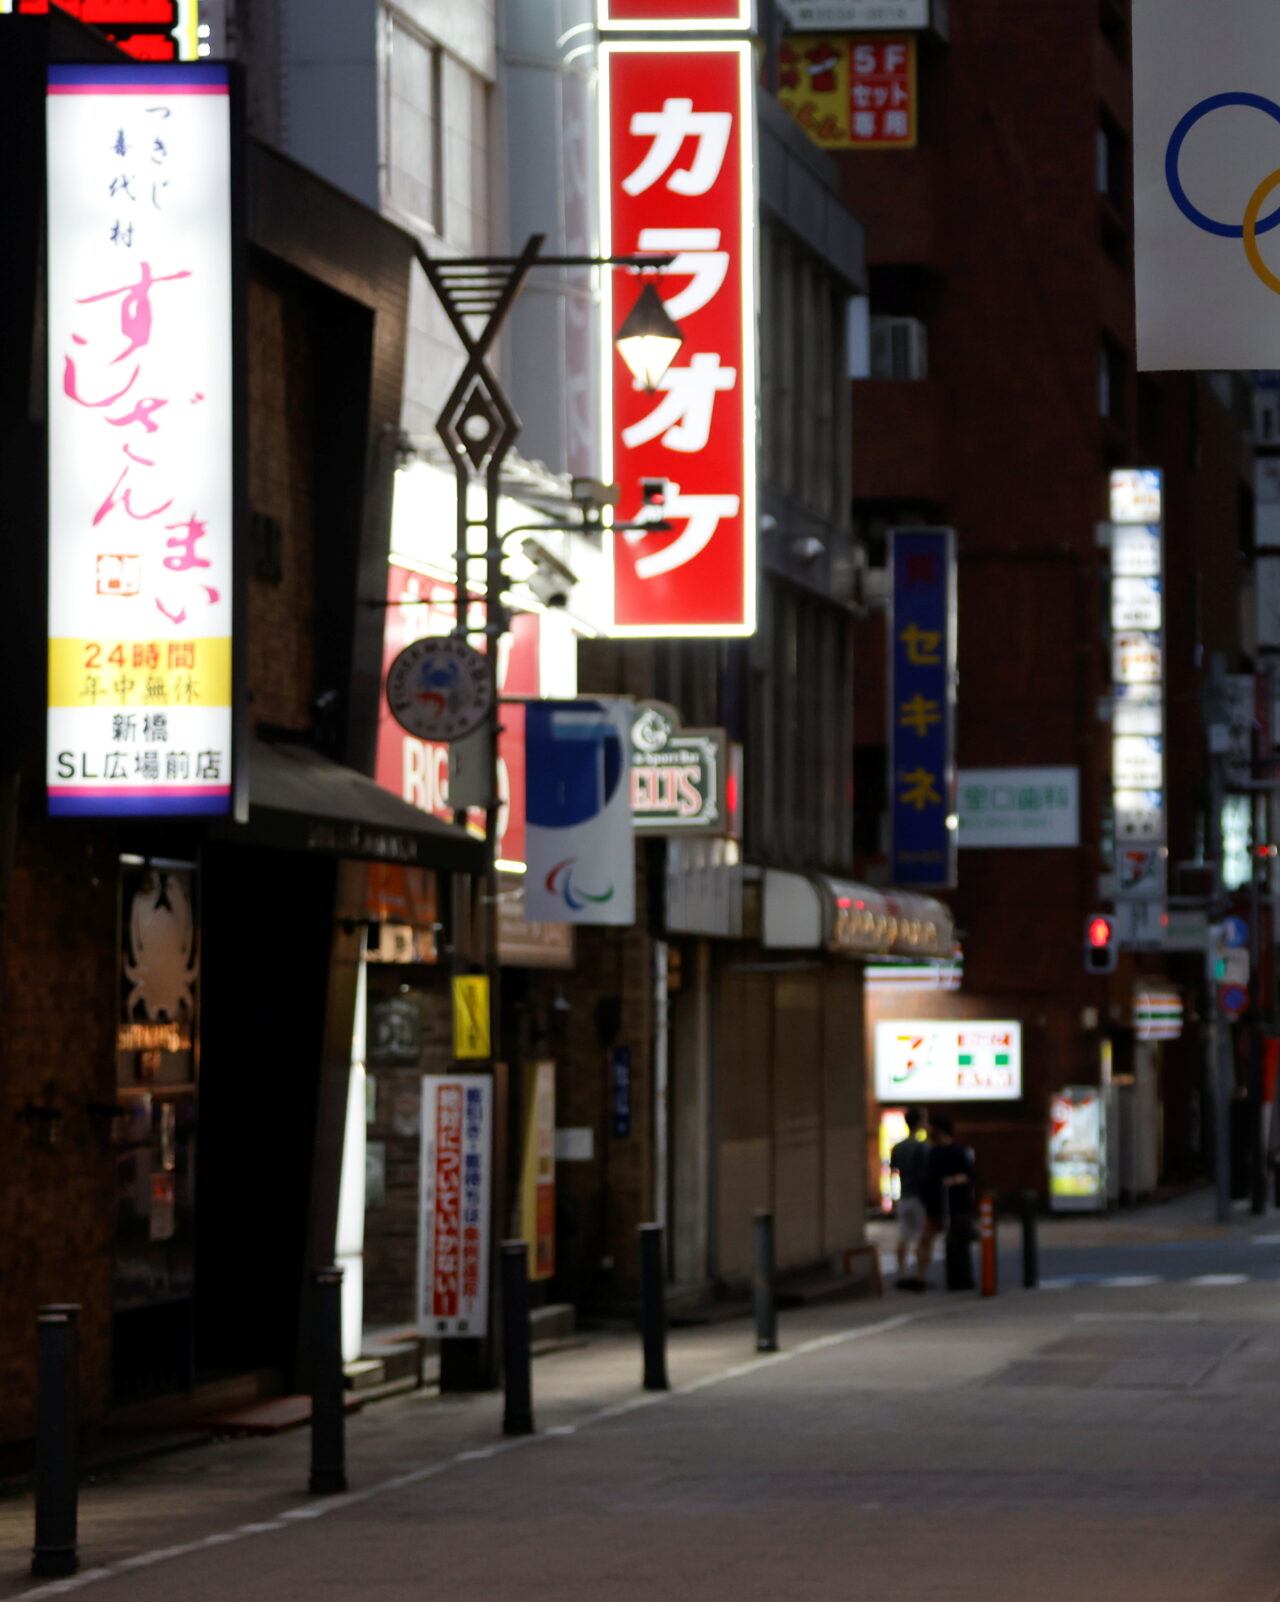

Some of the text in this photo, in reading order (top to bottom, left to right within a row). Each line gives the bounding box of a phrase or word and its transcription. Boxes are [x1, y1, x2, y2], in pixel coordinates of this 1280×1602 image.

[145, 105, 172, 211] つきじ
[622, 97, 740, 579] カラオケ
[84, 642, 197, 671] 24時間
[79, 674, 202, 705] 年中無休
[111, 713, 169, 744] 新橋
[899, 622, 943, 812] セキネ
[56, 749, 222, 780] SL広場前店
